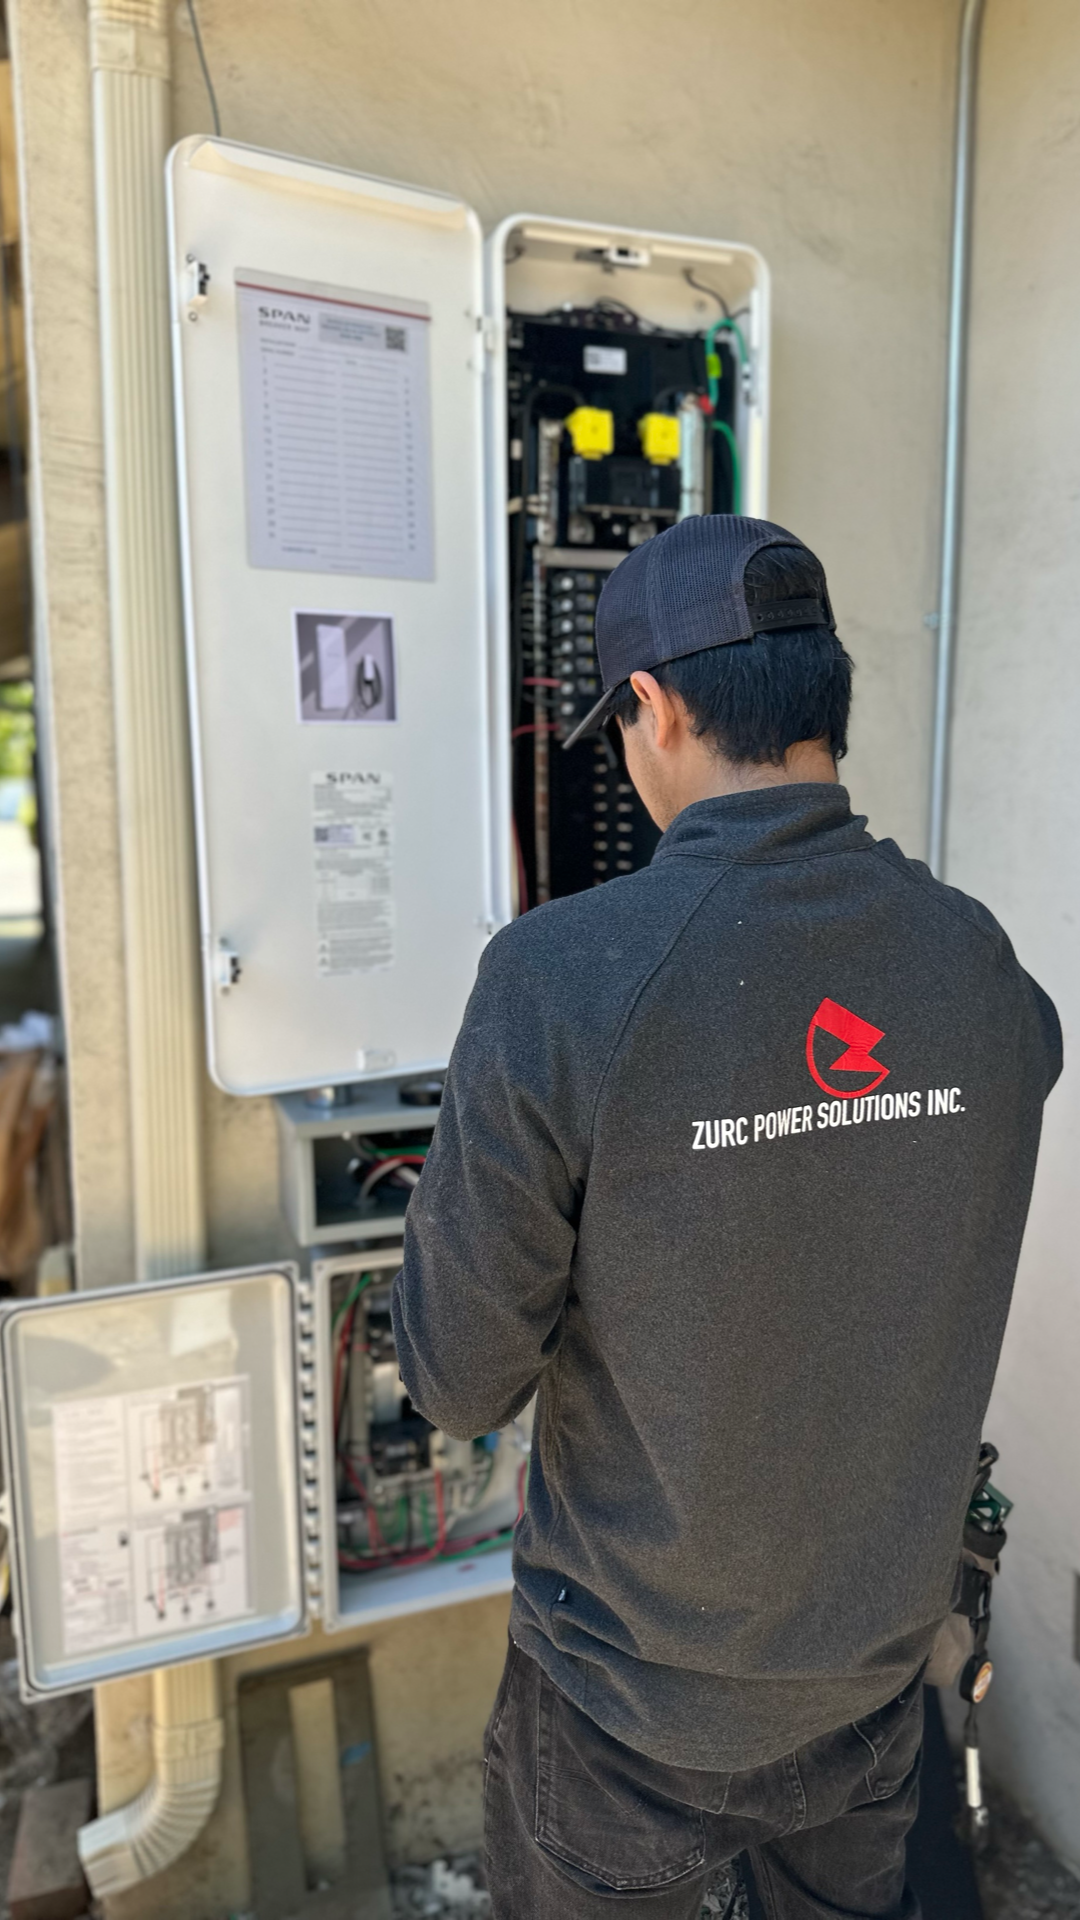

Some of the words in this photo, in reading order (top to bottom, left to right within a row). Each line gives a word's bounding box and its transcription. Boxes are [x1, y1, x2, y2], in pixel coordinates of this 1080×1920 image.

[258, 306, 311, 324] SPAN
[326, 772, 381, 785] SPAN
[692, 1117, 748, 1150] ZURC
[754, 1105, 813, 1142] POWER
[816, 1091, 922, 1129] SOLUTIONS
[927, 1087, 966, 1116] INC.
